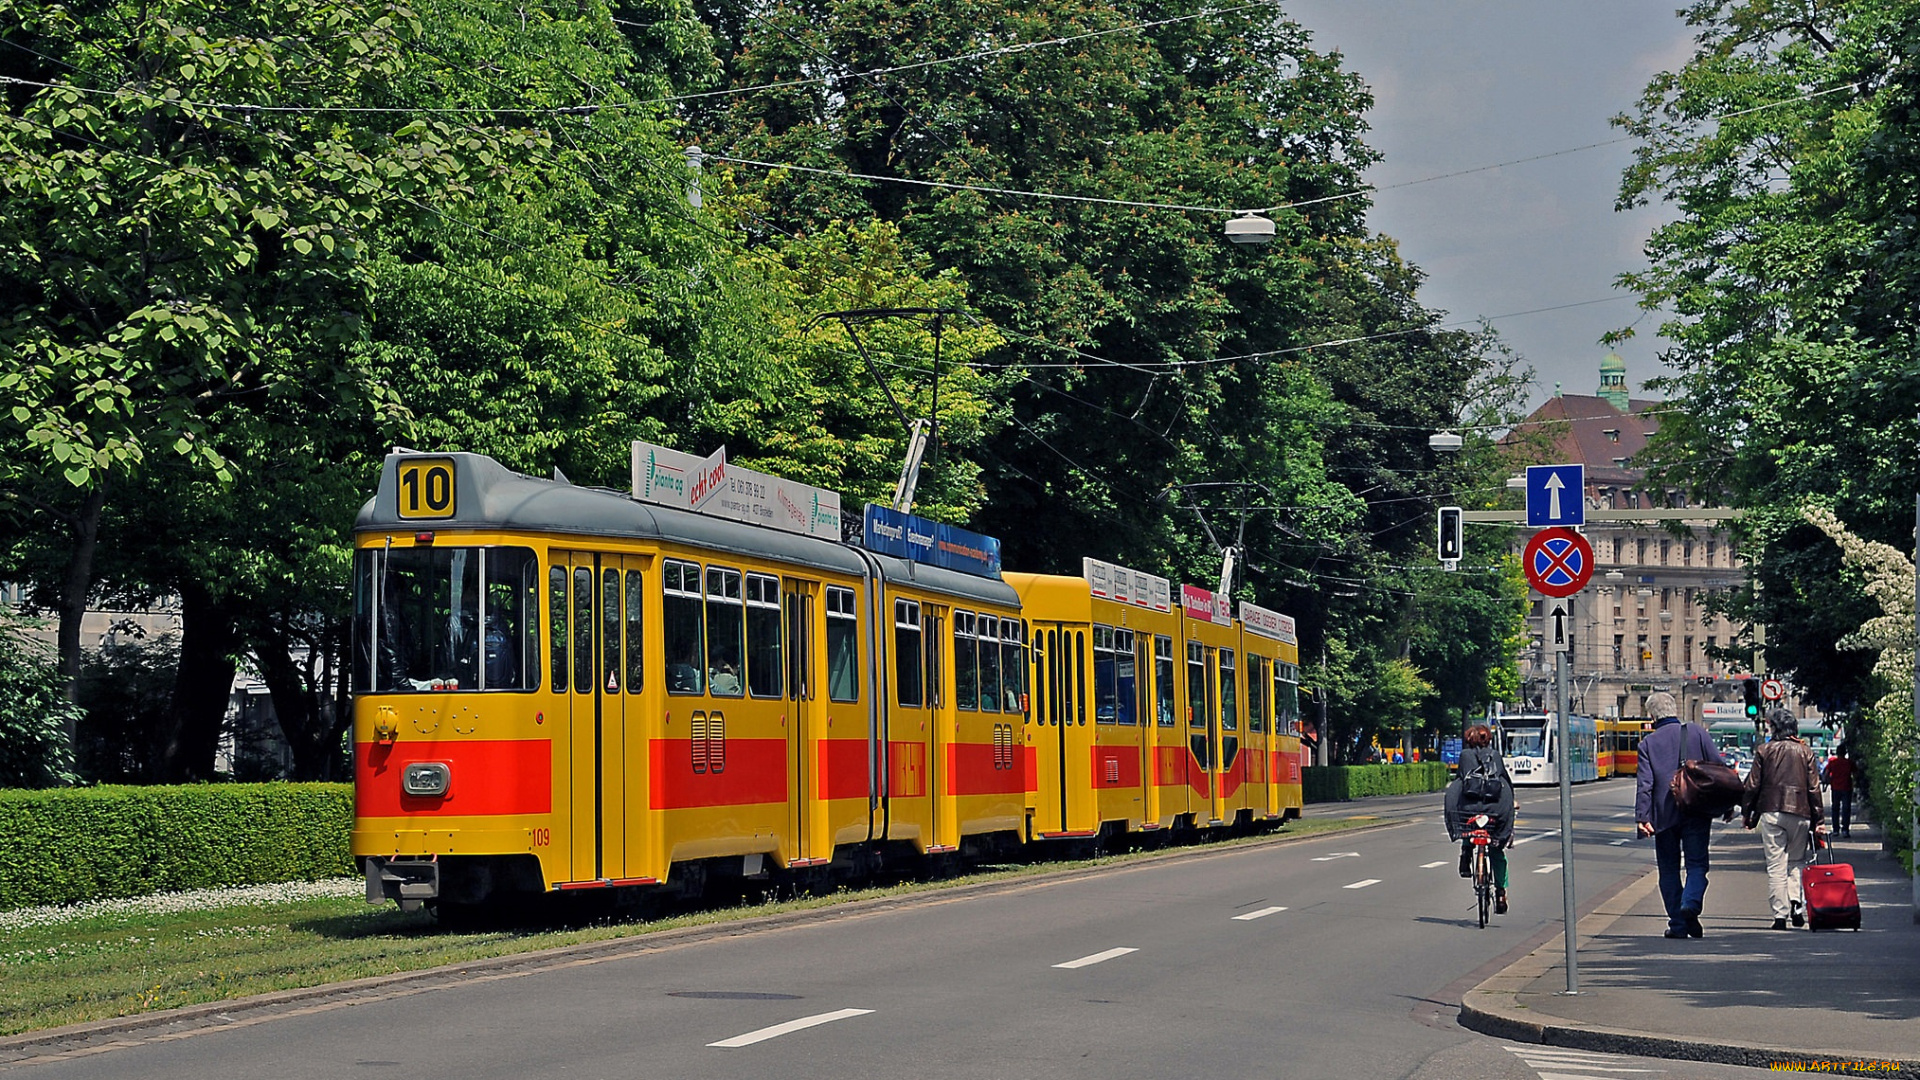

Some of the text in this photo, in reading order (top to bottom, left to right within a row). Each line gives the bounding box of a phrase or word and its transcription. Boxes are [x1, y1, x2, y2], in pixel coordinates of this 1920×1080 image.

[402, 467, 451, 511] 10
[654, 469, 683, 496] pianta ag
[691, 452, 726, 505] echt cool
[1244, 607, 1261, 625] GARAGE
[532, 828, 550, 846] 109
